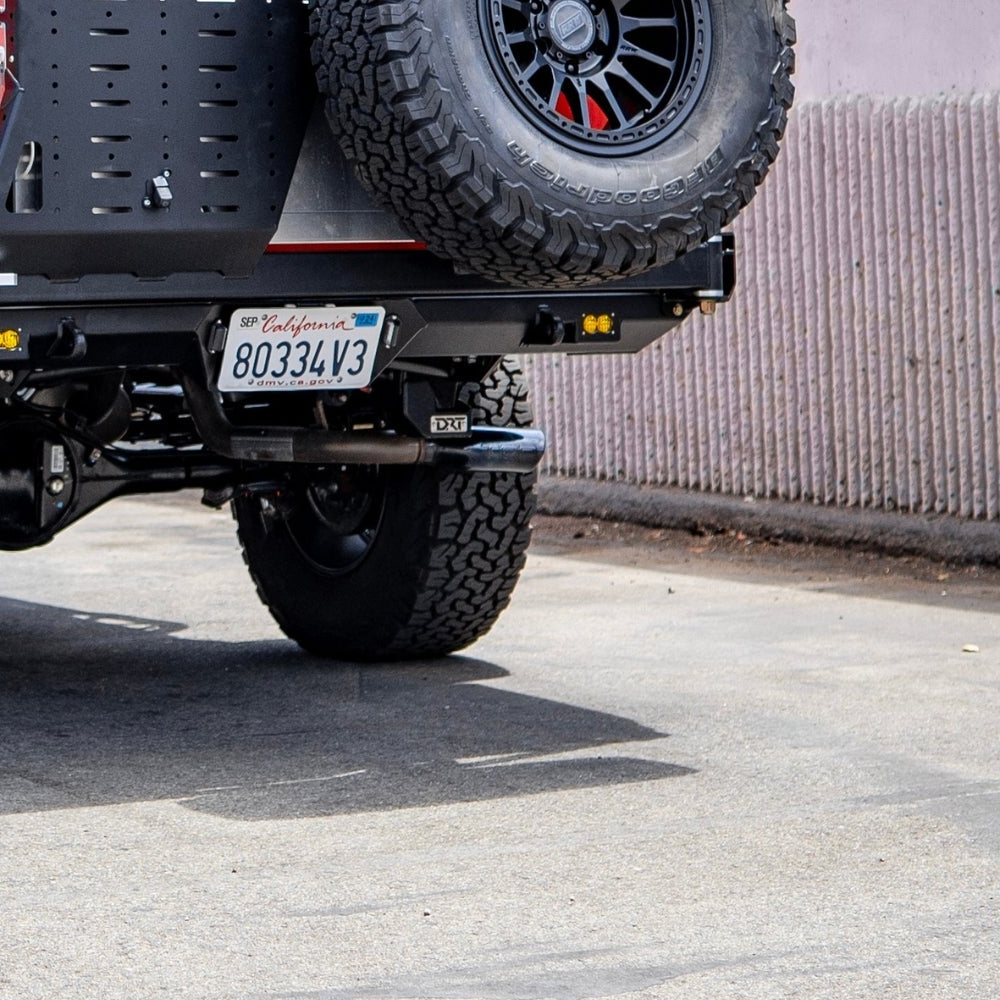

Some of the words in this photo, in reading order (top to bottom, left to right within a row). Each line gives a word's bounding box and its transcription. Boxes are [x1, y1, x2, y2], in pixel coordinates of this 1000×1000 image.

[240, 316, 258, 328] SEP
[262, 314, 354, 338] California
[232, 339, 368, 379] 80334V3
[256, 378, 334, 387] dmv.ca.gov
[435, 417, 466, 431] DRT
